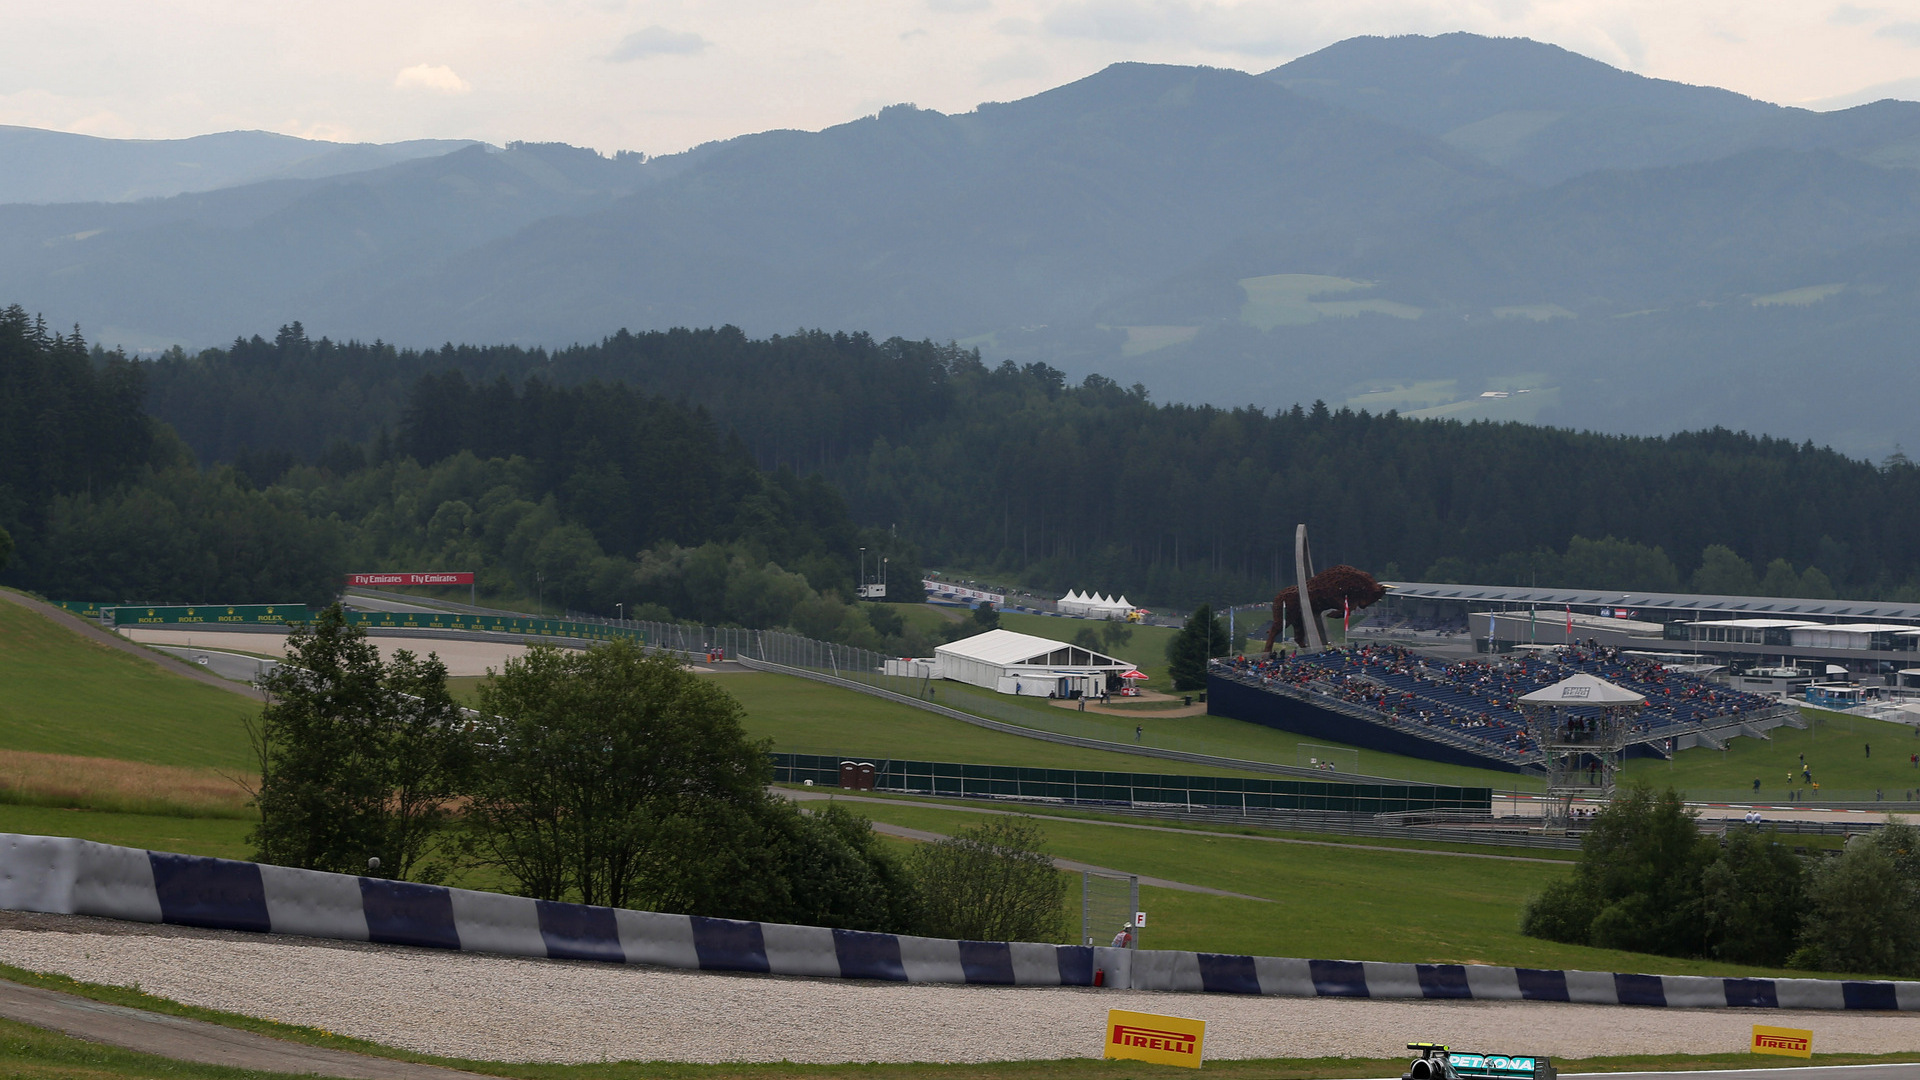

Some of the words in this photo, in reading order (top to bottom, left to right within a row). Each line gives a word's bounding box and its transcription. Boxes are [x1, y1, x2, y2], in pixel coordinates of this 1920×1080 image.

[355, 575, 369, 584] Fly
[369, 575, 402, 583] Emirates
[411, 574, 424, 584] Fly
[425, 574, 457, 583] Emirates
[1137, 915, 1144, 924] F
[1112, 1024, 1196, 1054] PIRELLI
[1755, 1034, 1808, 1051] PIRELLI
